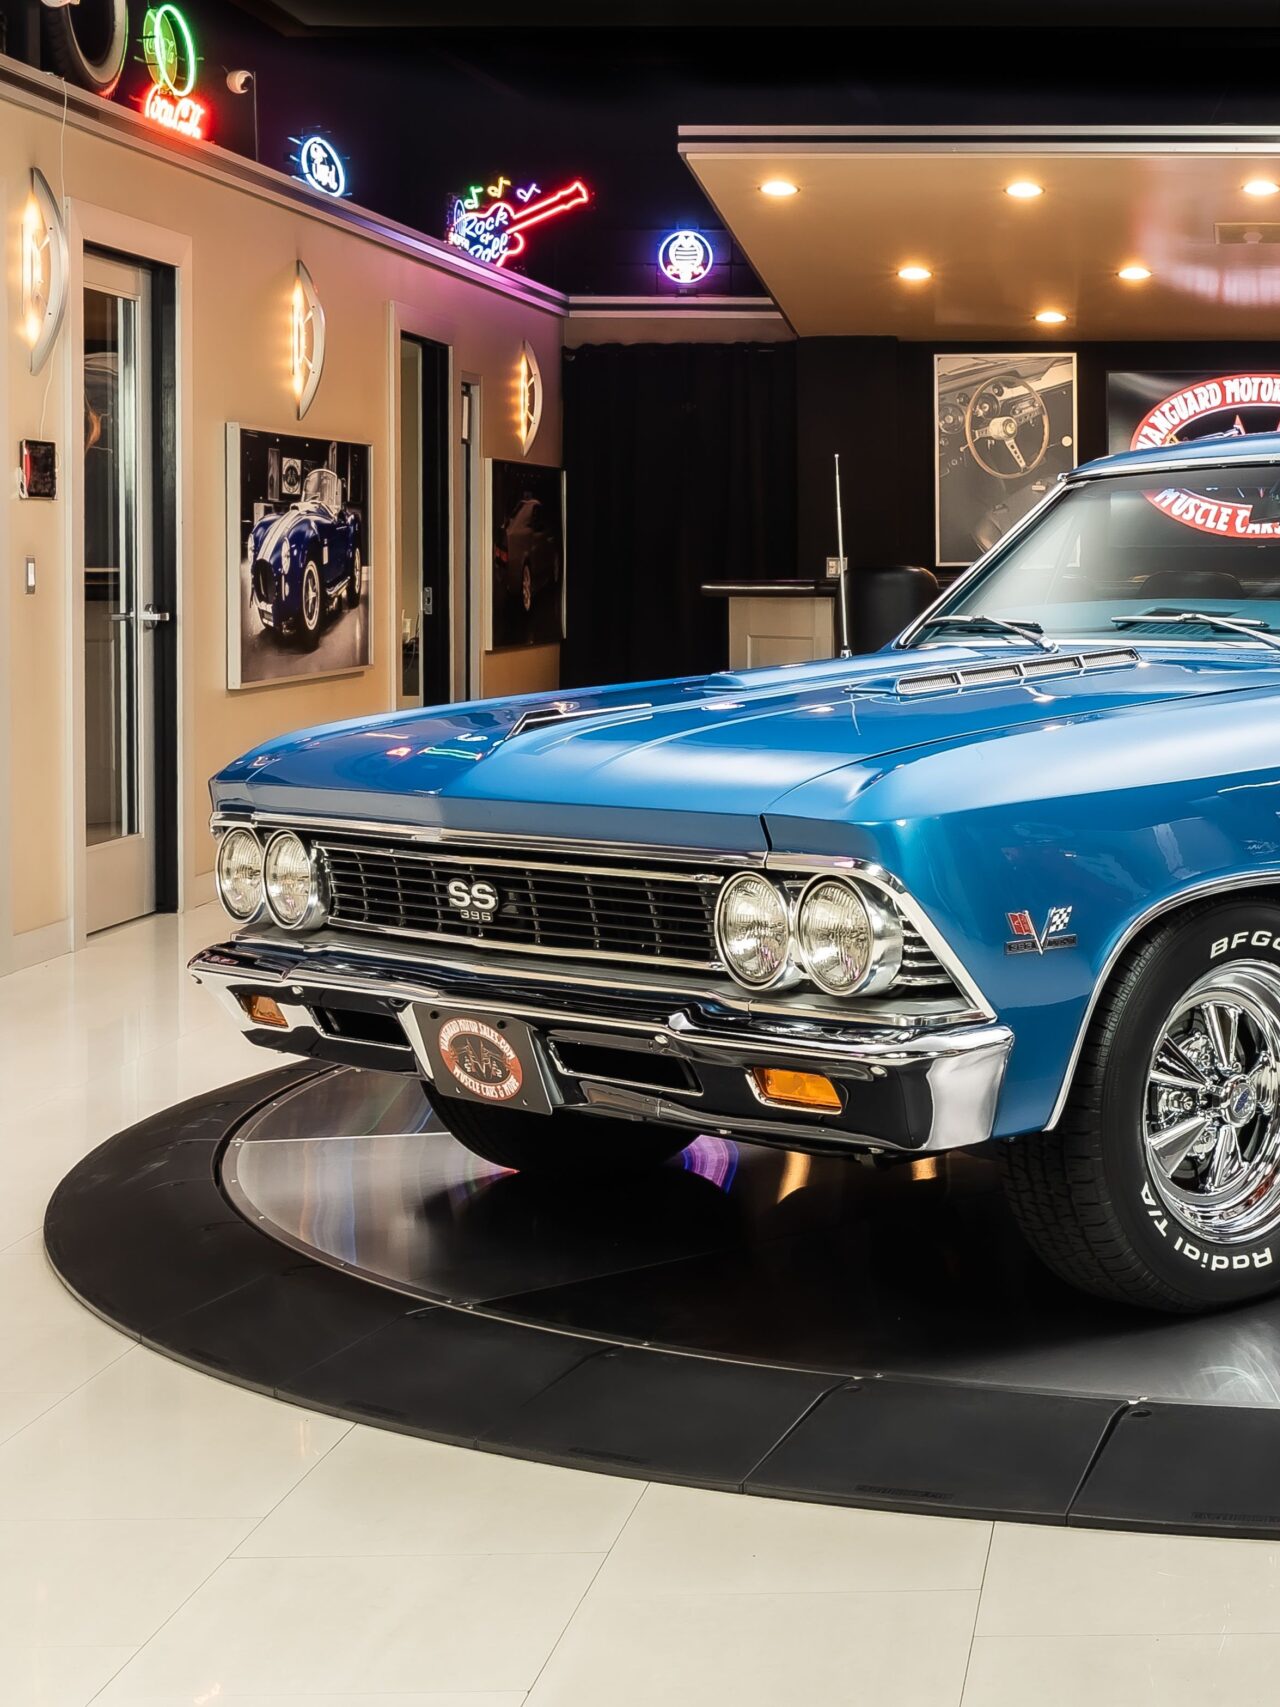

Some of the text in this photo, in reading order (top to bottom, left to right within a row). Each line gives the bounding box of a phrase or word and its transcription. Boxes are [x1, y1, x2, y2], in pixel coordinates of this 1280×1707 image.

[464, 205, 509, 237] Rock
[1136, 382, 1222, 450] VANGUARD
[1153, 488, 1232, 532] MUSCLE
[448, 881, 496, 910] SS
[460, 909, 492, 921] 396
[478, 1021, 515, 1060] SALES.COM
[453, 1065, 480, 1094] MUSCLE
[1141, 1181, 1273, 1271] Radial T/A
